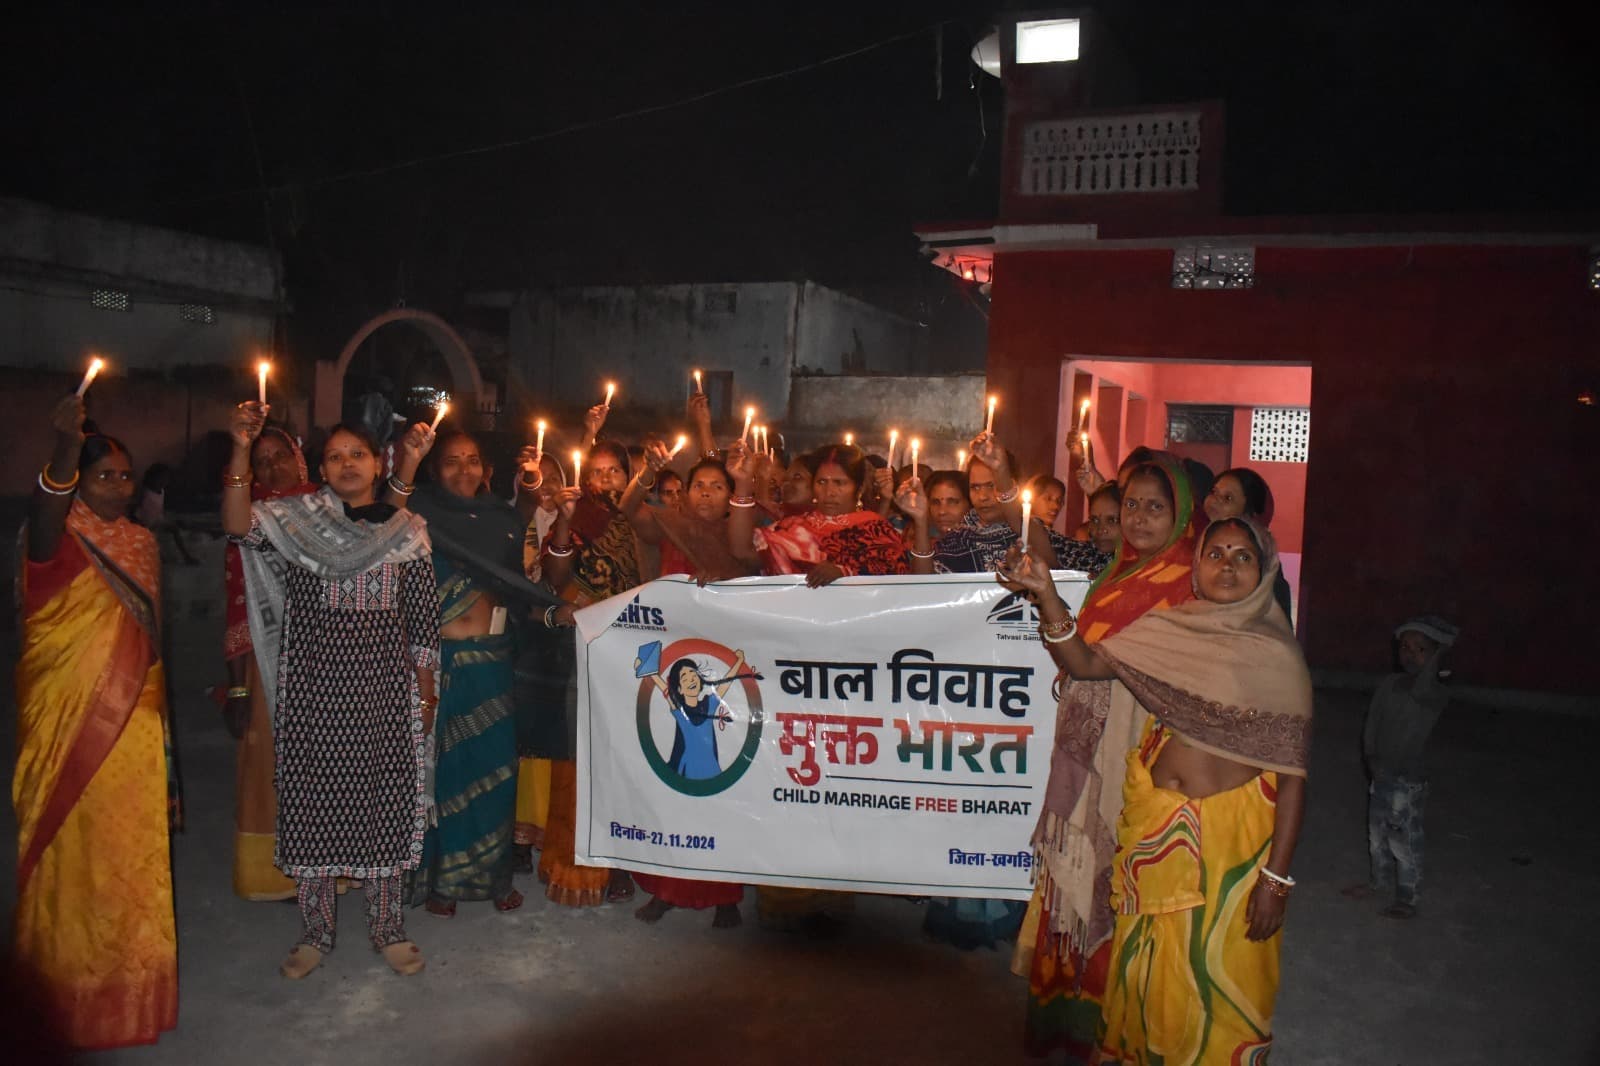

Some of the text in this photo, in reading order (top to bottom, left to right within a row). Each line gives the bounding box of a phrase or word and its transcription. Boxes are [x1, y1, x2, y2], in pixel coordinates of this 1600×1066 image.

[616, 603, 665, 626] GHTS
[775, 648, 1034, 717] बाल विवाह
[776, 712, 1034, 787] मुक्त भारत
[773, 787, 1032, 816] CHILD MARRIAGE FREE BHARAT
